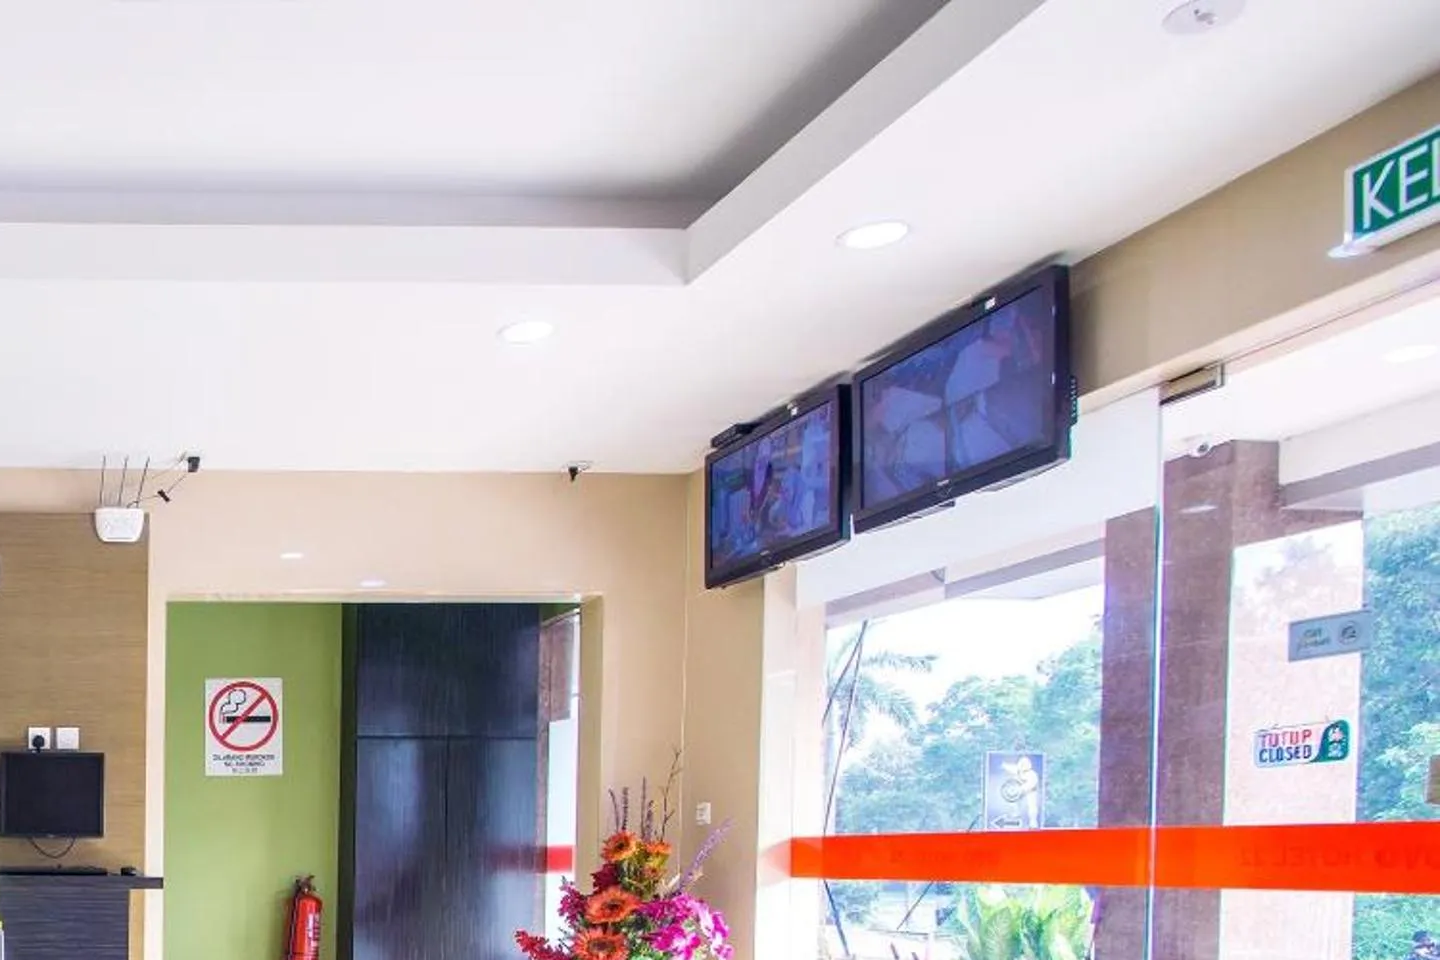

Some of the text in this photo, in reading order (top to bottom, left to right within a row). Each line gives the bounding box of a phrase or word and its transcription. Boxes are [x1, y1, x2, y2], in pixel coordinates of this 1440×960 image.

[1363, 137, 1440, 229] KE
[1258, 729, 1312, 748] TUTUP
[1259, 744, 1312, 763] CLOSED
